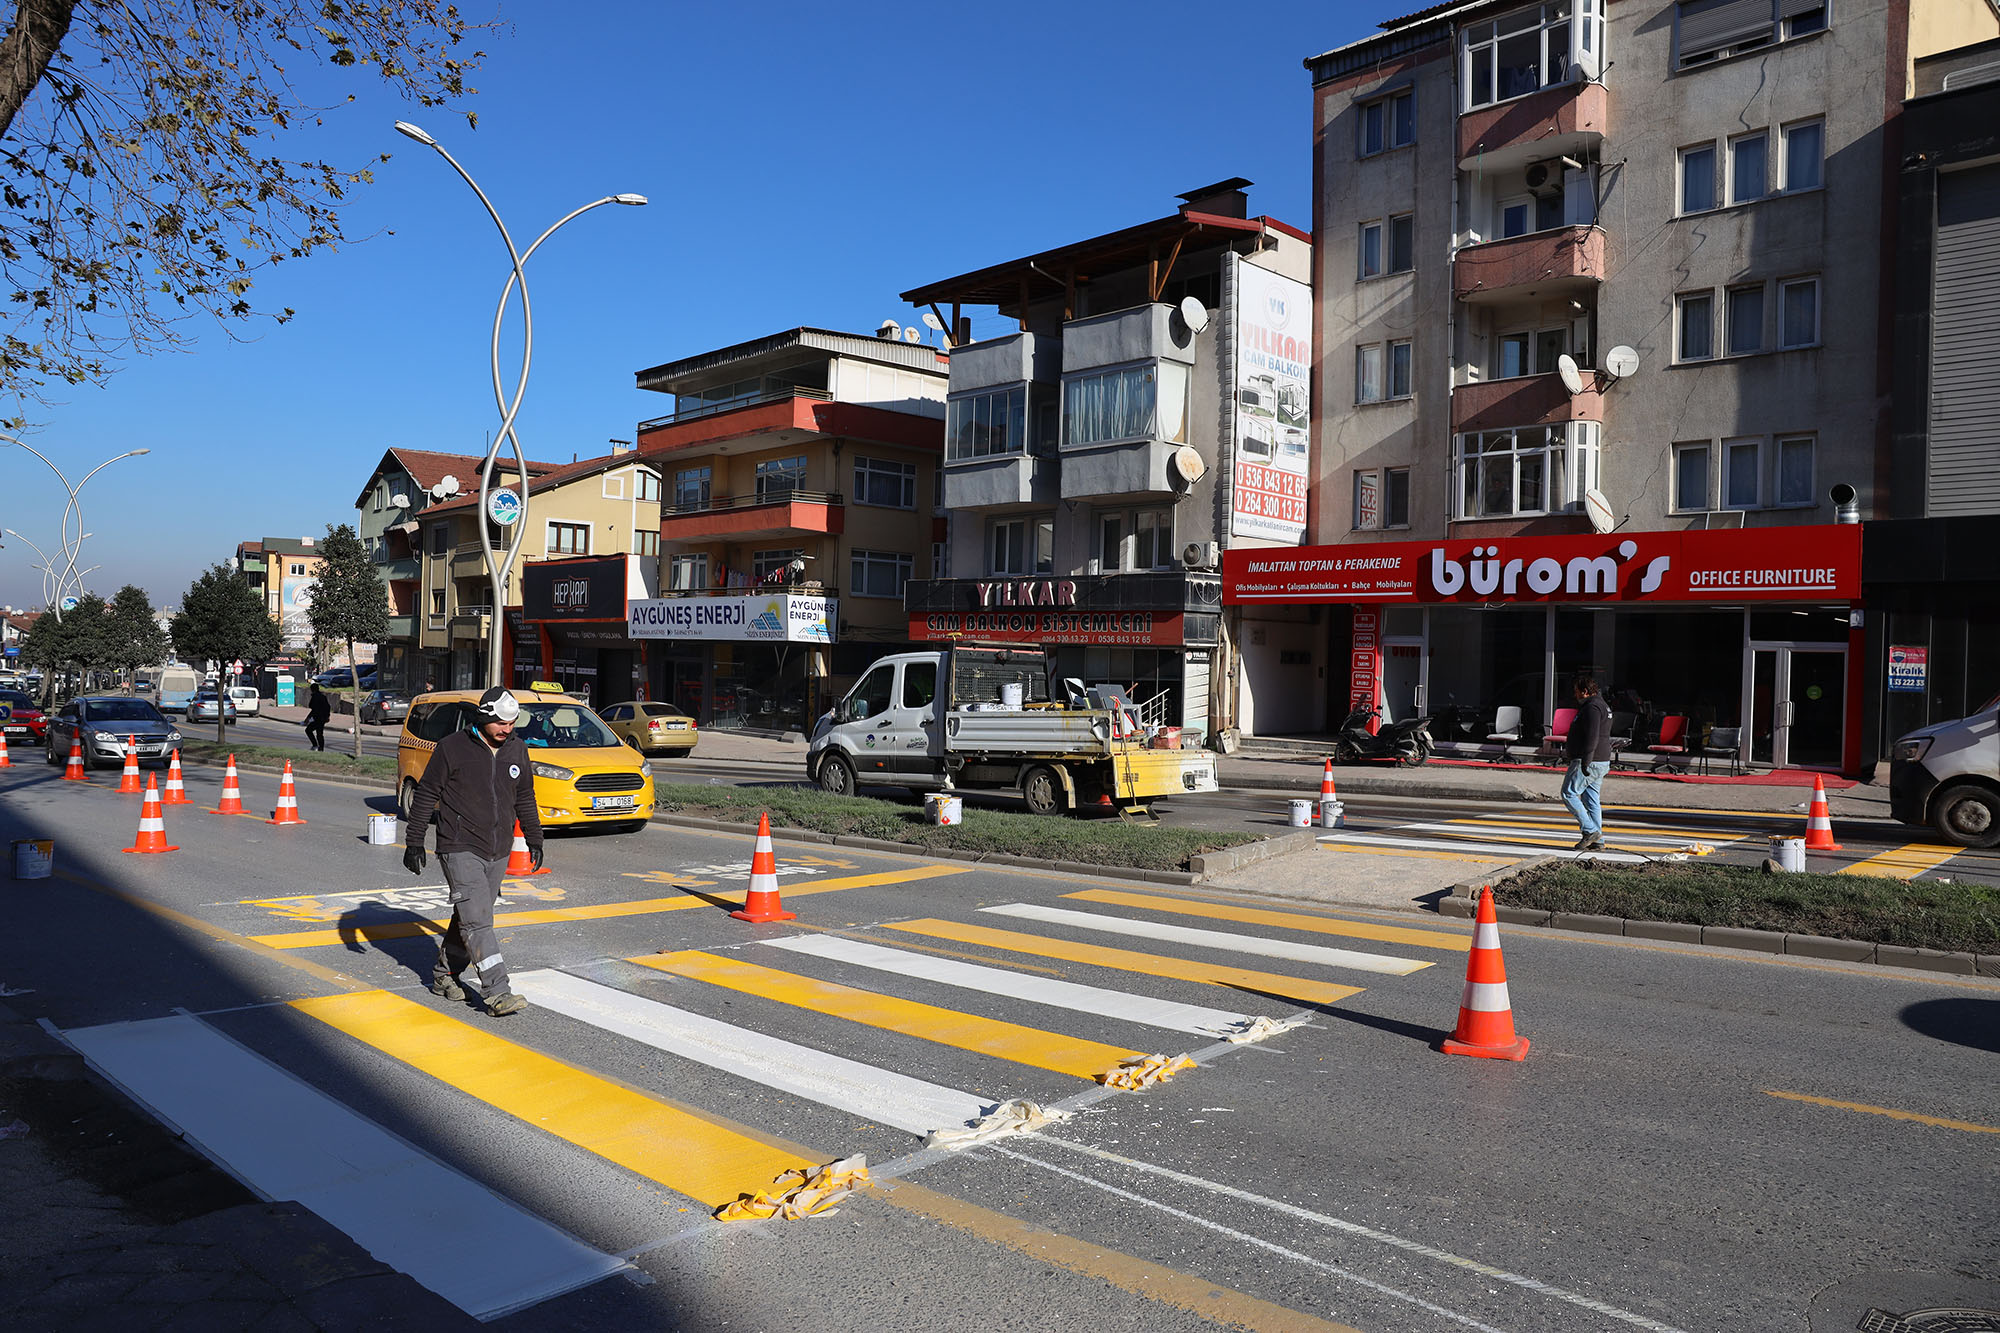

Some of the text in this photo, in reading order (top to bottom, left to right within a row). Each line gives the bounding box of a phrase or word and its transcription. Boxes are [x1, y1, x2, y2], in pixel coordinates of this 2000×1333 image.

[1269, 297, 1285, 316] YK
[1241, 320, 1310, 366] YILKAR
[1244, 350, 1307, 380] CAM BALKON
[1237, 464, 1306, 497] 0 536 843 12 65
[1236, 491, 1305, 522] 0 264 300 13 23
[1248, 557, 1402, 573] İMALATTAN TOPTAN & PERAKENDE
[1689, 568, 1836, 585] OFFICE FURNITURE
[554, 580, 588, 607] HEP KAPI
[976, 580, 1077, 607] YILKAR
[1286, 582, 1310, 593] Çalışma
[1309, 581, 1339, 591] Koltukları
[1351, 581, 1371, 591] Bahçe
[1376, 579, 1412, 590] Mobilyaları
[632, 599, 746, 630] AYGÜNEŞ ENERJİ
[789, 611, 820, 622] ENERJİ
[790, 600, 836, 615] AYGÜNEŞ
[926, 614, 961, 632] CAM
[965, 614, 1037, 632] BALKON
[1080, 635, 1089, 643] 23
[1098, 635, 1116, 643] 0536
[1116, 635, 1130, 643] 843
[1142, 636, 1151, 644] 65
[1891, 665, 1924, 675] Kiralık
[597, 798, 606, 807] 54
